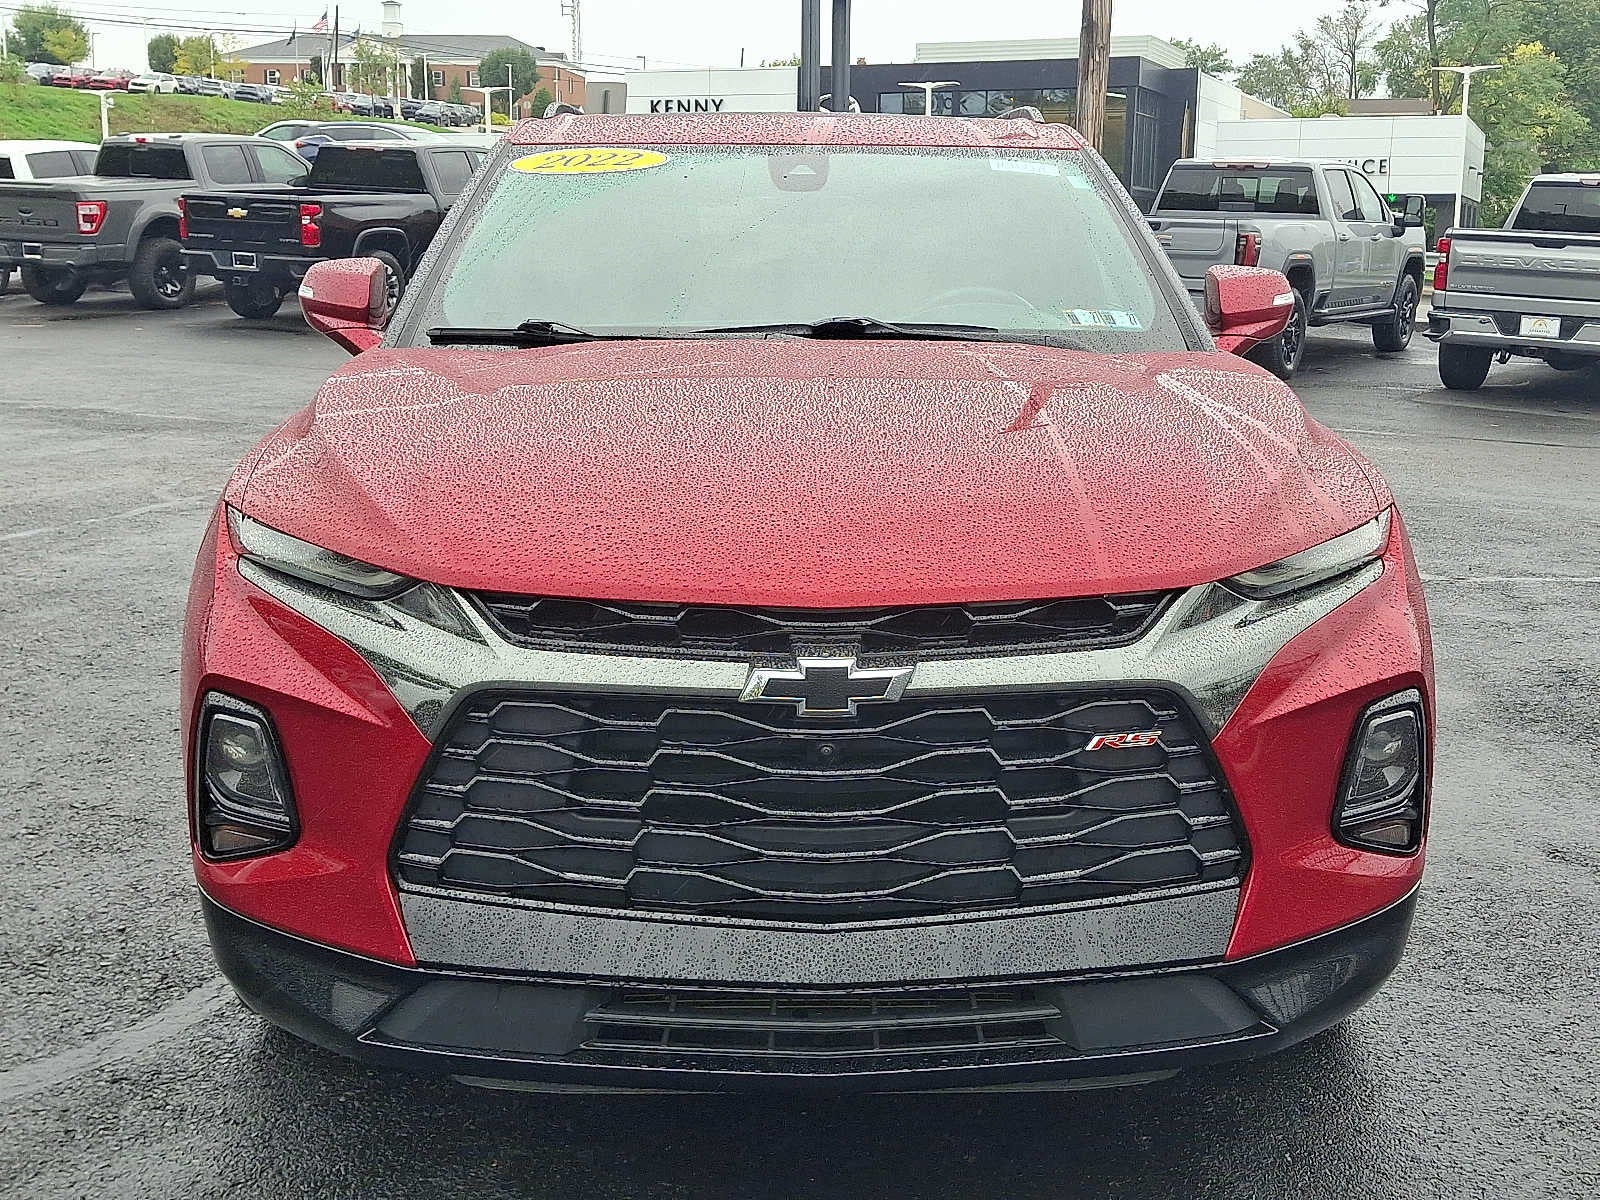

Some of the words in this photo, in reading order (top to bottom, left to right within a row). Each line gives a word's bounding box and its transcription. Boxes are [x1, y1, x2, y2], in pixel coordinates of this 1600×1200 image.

[650, 98, 724, 114] KENNY
[535, 152, 643, 169] 2022
[1085, 730, 1163, 751] RS
